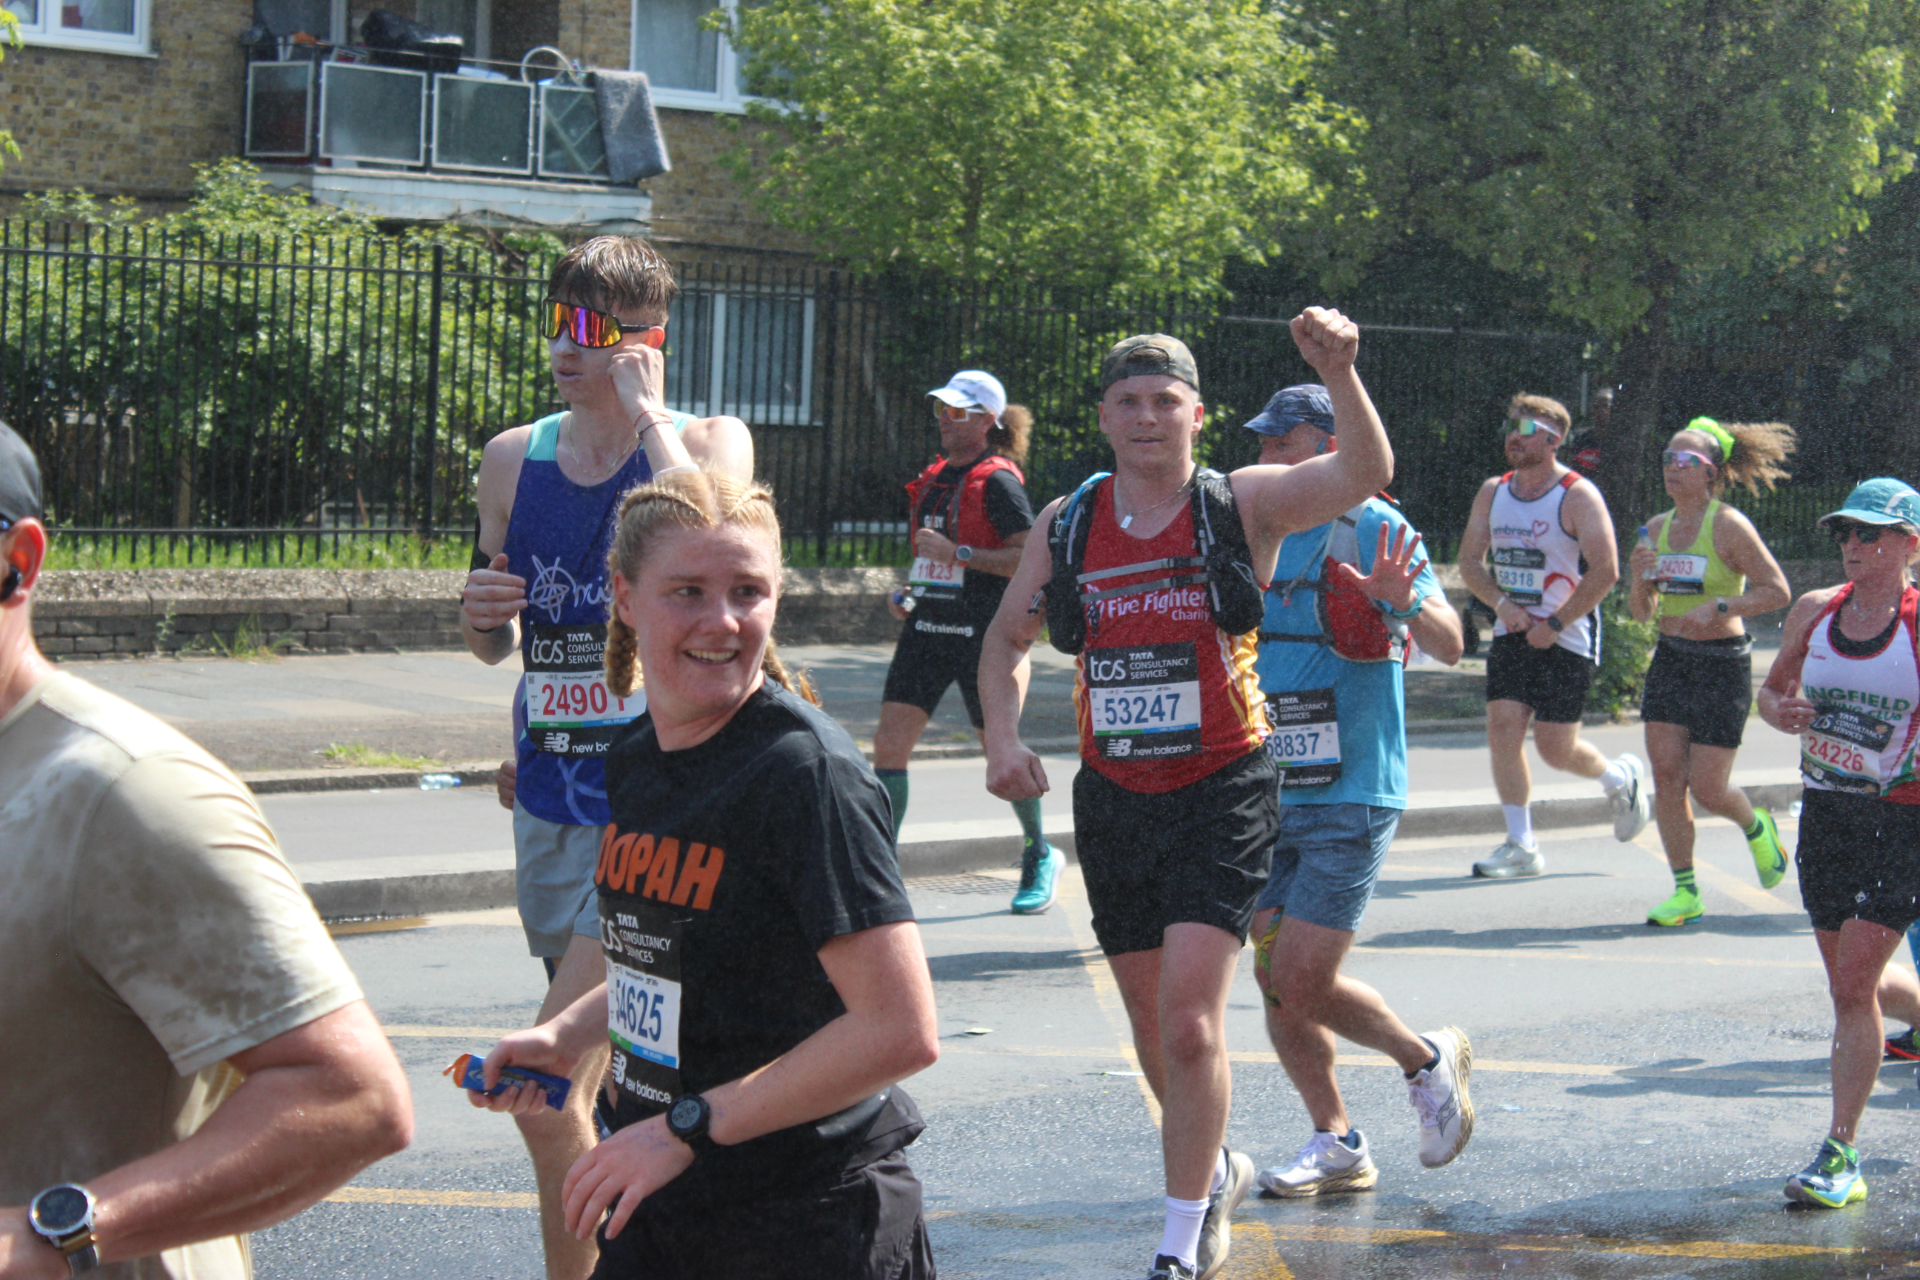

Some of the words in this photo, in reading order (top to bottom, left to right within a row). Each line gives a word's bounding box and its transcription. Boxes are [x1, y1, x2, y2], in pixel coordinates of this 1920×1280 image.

[1499, 570, 1534, 587] 58318
[1107, 597, 1140, 618] Fire
[1143, 588, 1207, 614] Fighter
[1171, 609, 1210, 622] Charity
[566, 633, 593, 642] TATA
[531, 634, 564, 664] tcs
[567, 641, 607, 653] CONSULT
[568, 653, 604, 664] SERVICE
[1128, 651, 1154, 660] TATA
[1090, 655, 1126, 681] tcs
[1129, 657, 1189, 670] CONSULTANCY
[1130, 669, 1168, 680] SERVICES
[1805, 685, 1911, 712] INGFIELD
[1104, 693, 1180, 725] 53247
[1279, 702, 1328, 713] CONSULTANCY
[1280, 711, 1310, 720] SERVICES
[1838, 712, 1859, 724] TATA
[1832, 726, 1864, 741] SERVICES
[1836, 719, 1884, 740] CONSULTANCY
[571, 744, 594, 753] new
[1133, 748, 1152, 756] new
[1153, 744, 1192, 755] balance
[1808, 736, 1864, 772] 24226
[1299, 775, 1332, 785] balance
[1836, 784, 1866, 794] balanc
[616, 912, 639, 929] TATA
[600, 916, 623, 953] cs
[619, 929, 671, 951] CONSULTANCY
[624, 944, 654, 963] SERVICES
[636, 1080, 672, 1104] balance
